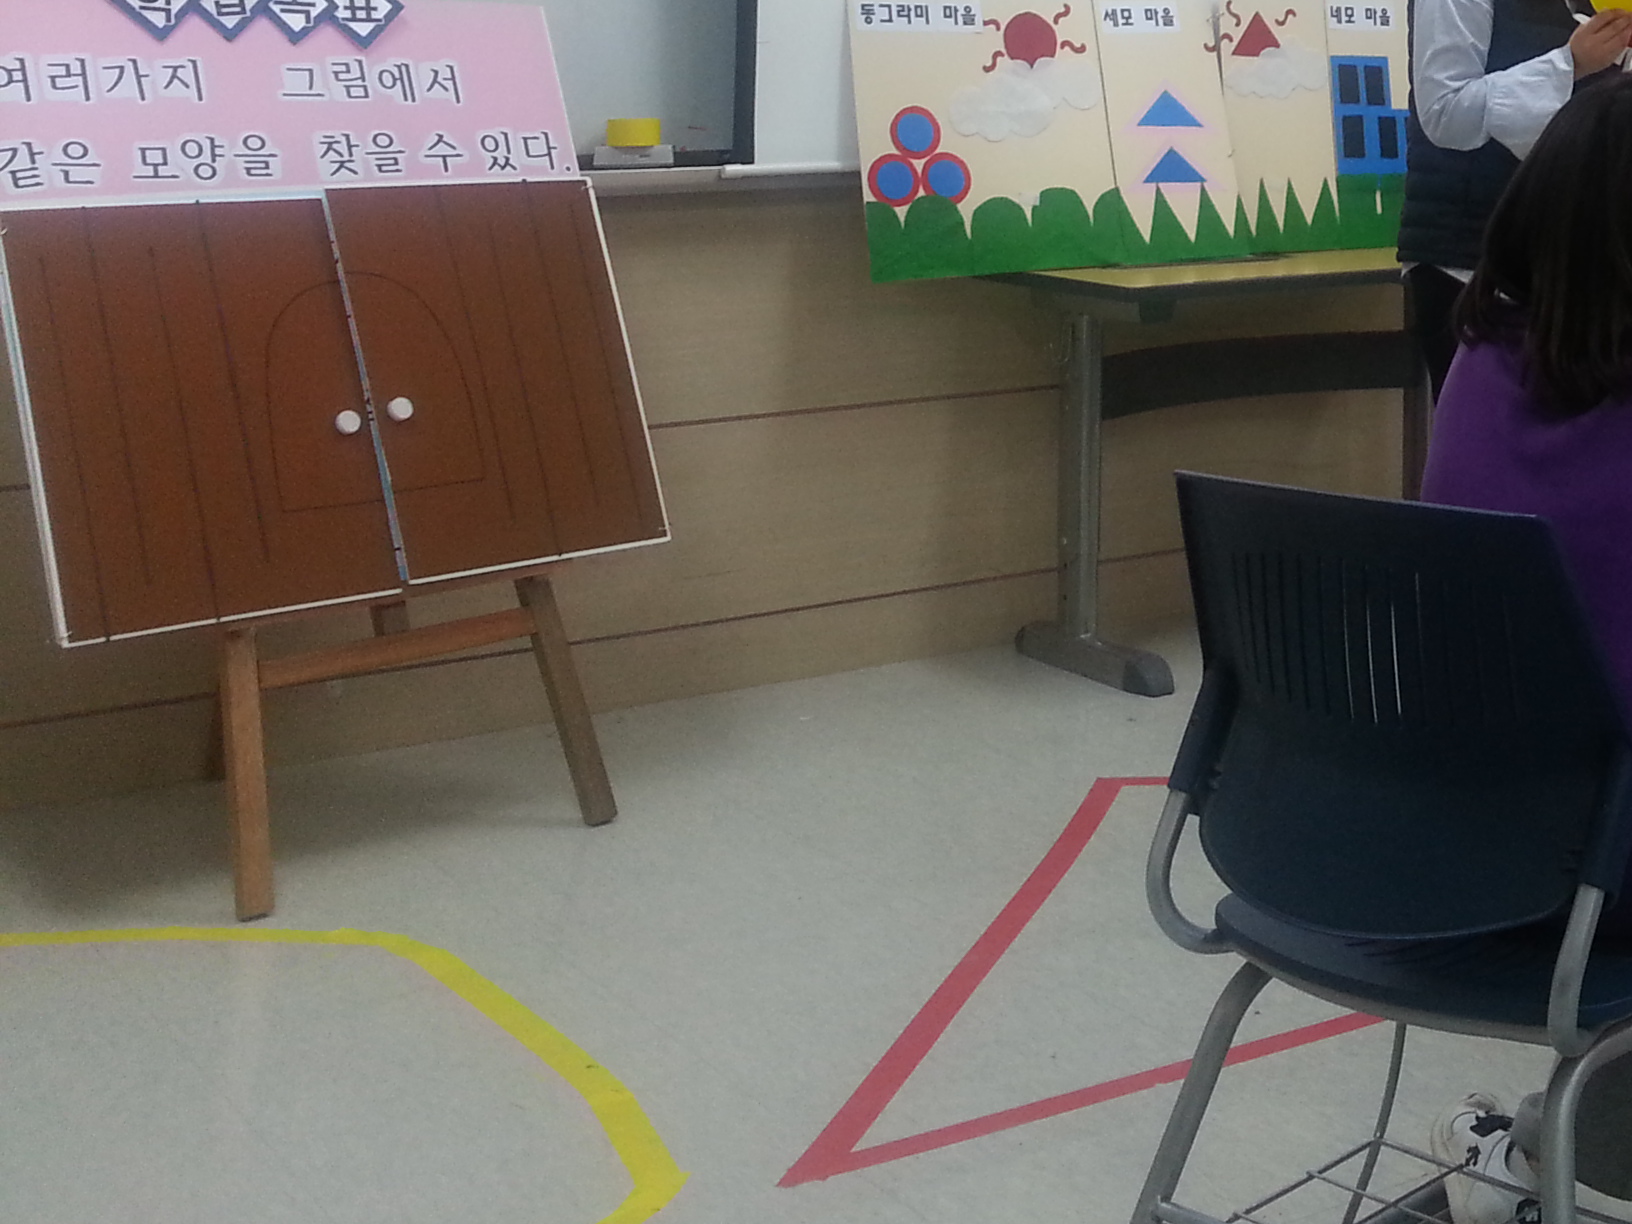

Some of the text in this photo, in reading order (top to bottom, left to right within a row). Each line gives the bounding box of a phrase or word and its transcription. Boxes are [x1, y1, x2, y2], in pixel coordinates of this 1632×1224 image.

[859, 2, 977, 27] 동그라미 마을
[1102, 7, 1175, 28] 세모 마을
[1329, 6, 1391, 27] 네모 마을
[0, 57, 464, 105] 여러가지 그림에서
[0, 131, 573, 189] 같은 모양을 찾을 수 있다.
